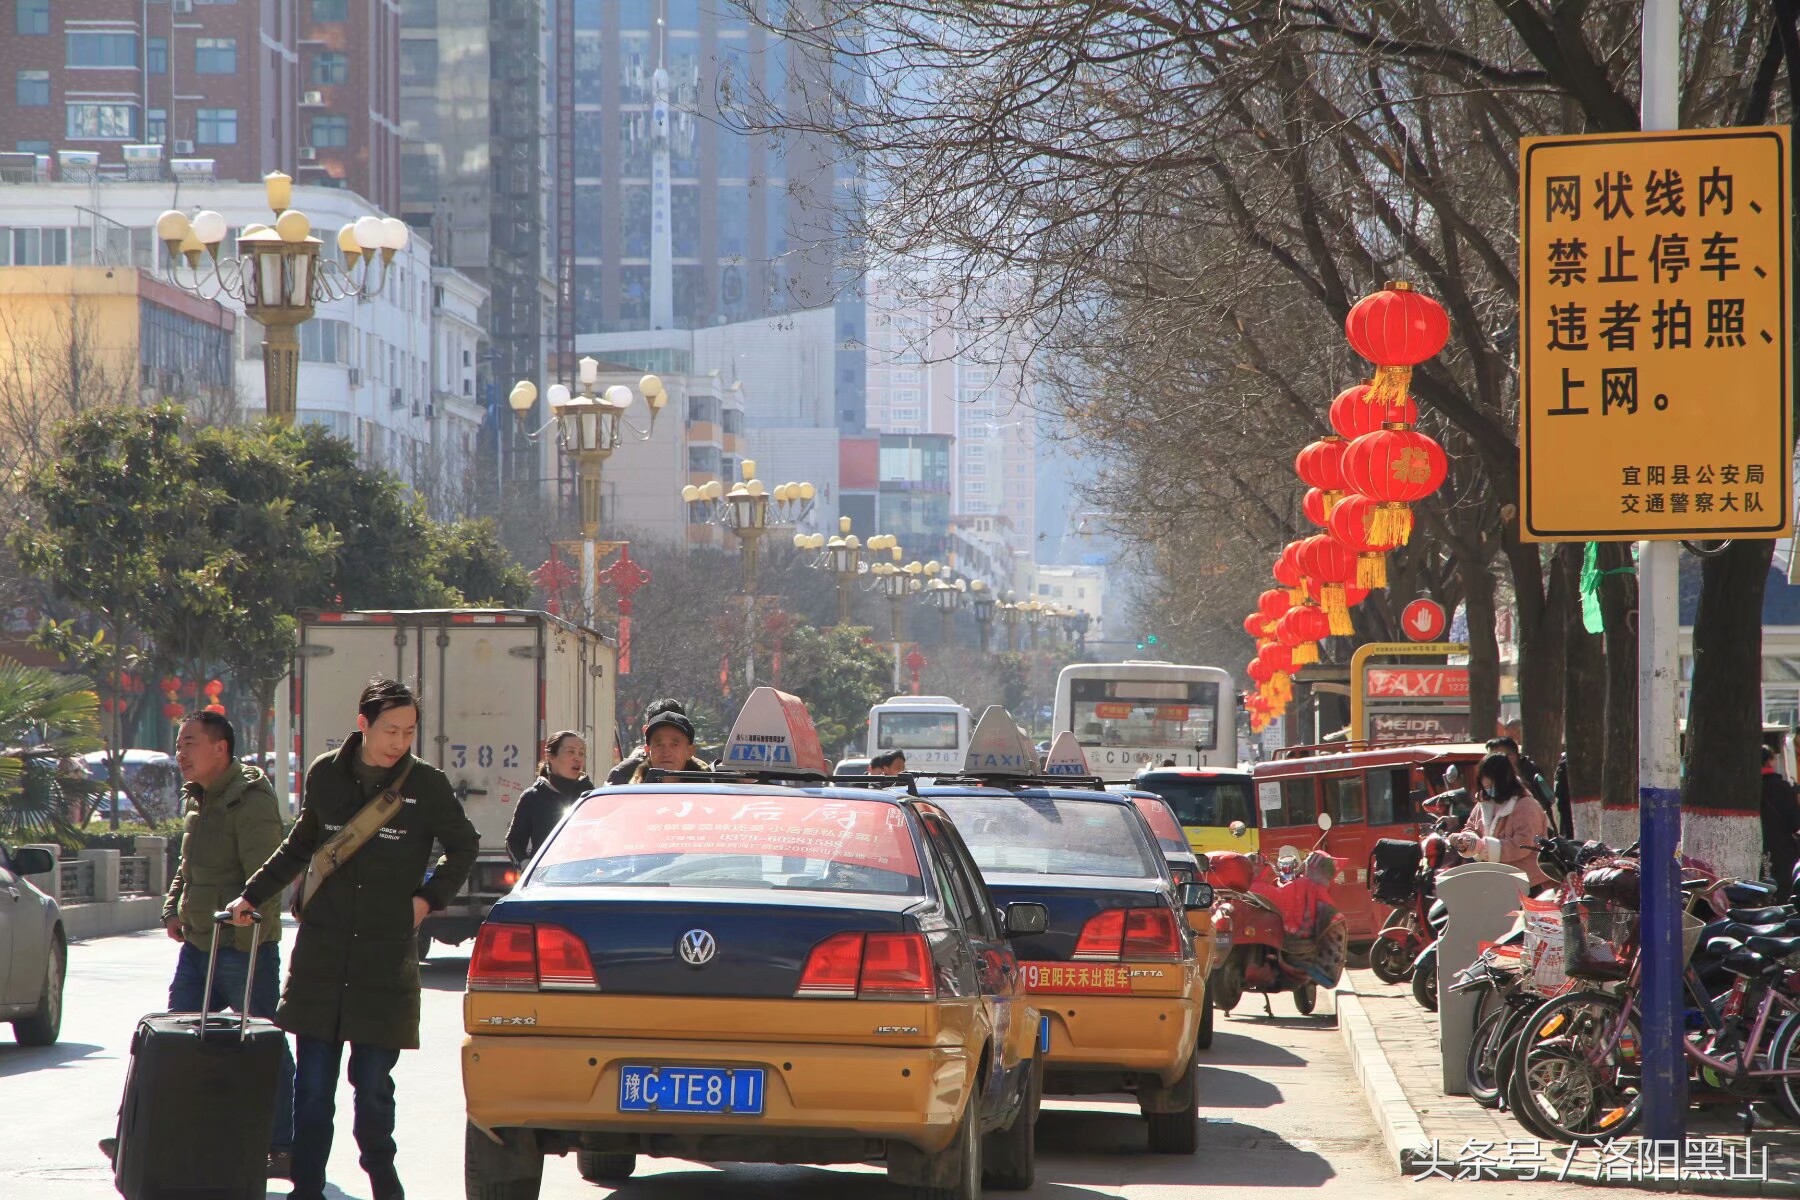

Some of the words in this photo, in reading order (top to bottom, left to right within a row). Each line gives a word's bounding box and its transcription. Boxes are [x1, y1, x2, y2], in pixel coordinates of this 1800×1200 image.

[1546, 165, 1763, 223] 网状线内、
[1547, 231, 1768, 288] 禁止停车、
[1546, 298, 1774, 353] 违者拍照、
[1547, 366, 1669, 417] 上网。
[1391, 447, 1431, 484] 福
[1621, 464, 1765, 486] 宜阳县公安局
[1620, 491, 1765, 514] 交通警察大队
[1374, 673, 1443, 694] TAXI
[450, 743, 519, 770] 382
[734, 745, 787, 761] TAXI
[969, 753, 1021, 767] TAXI
[1050, 765, 1083, 775] TAXI
[656, 800, 874, 831] 小后厨
[1127, 969, 1164, 977] JETTA
[873, 1025, 920, 1034] JETTA
